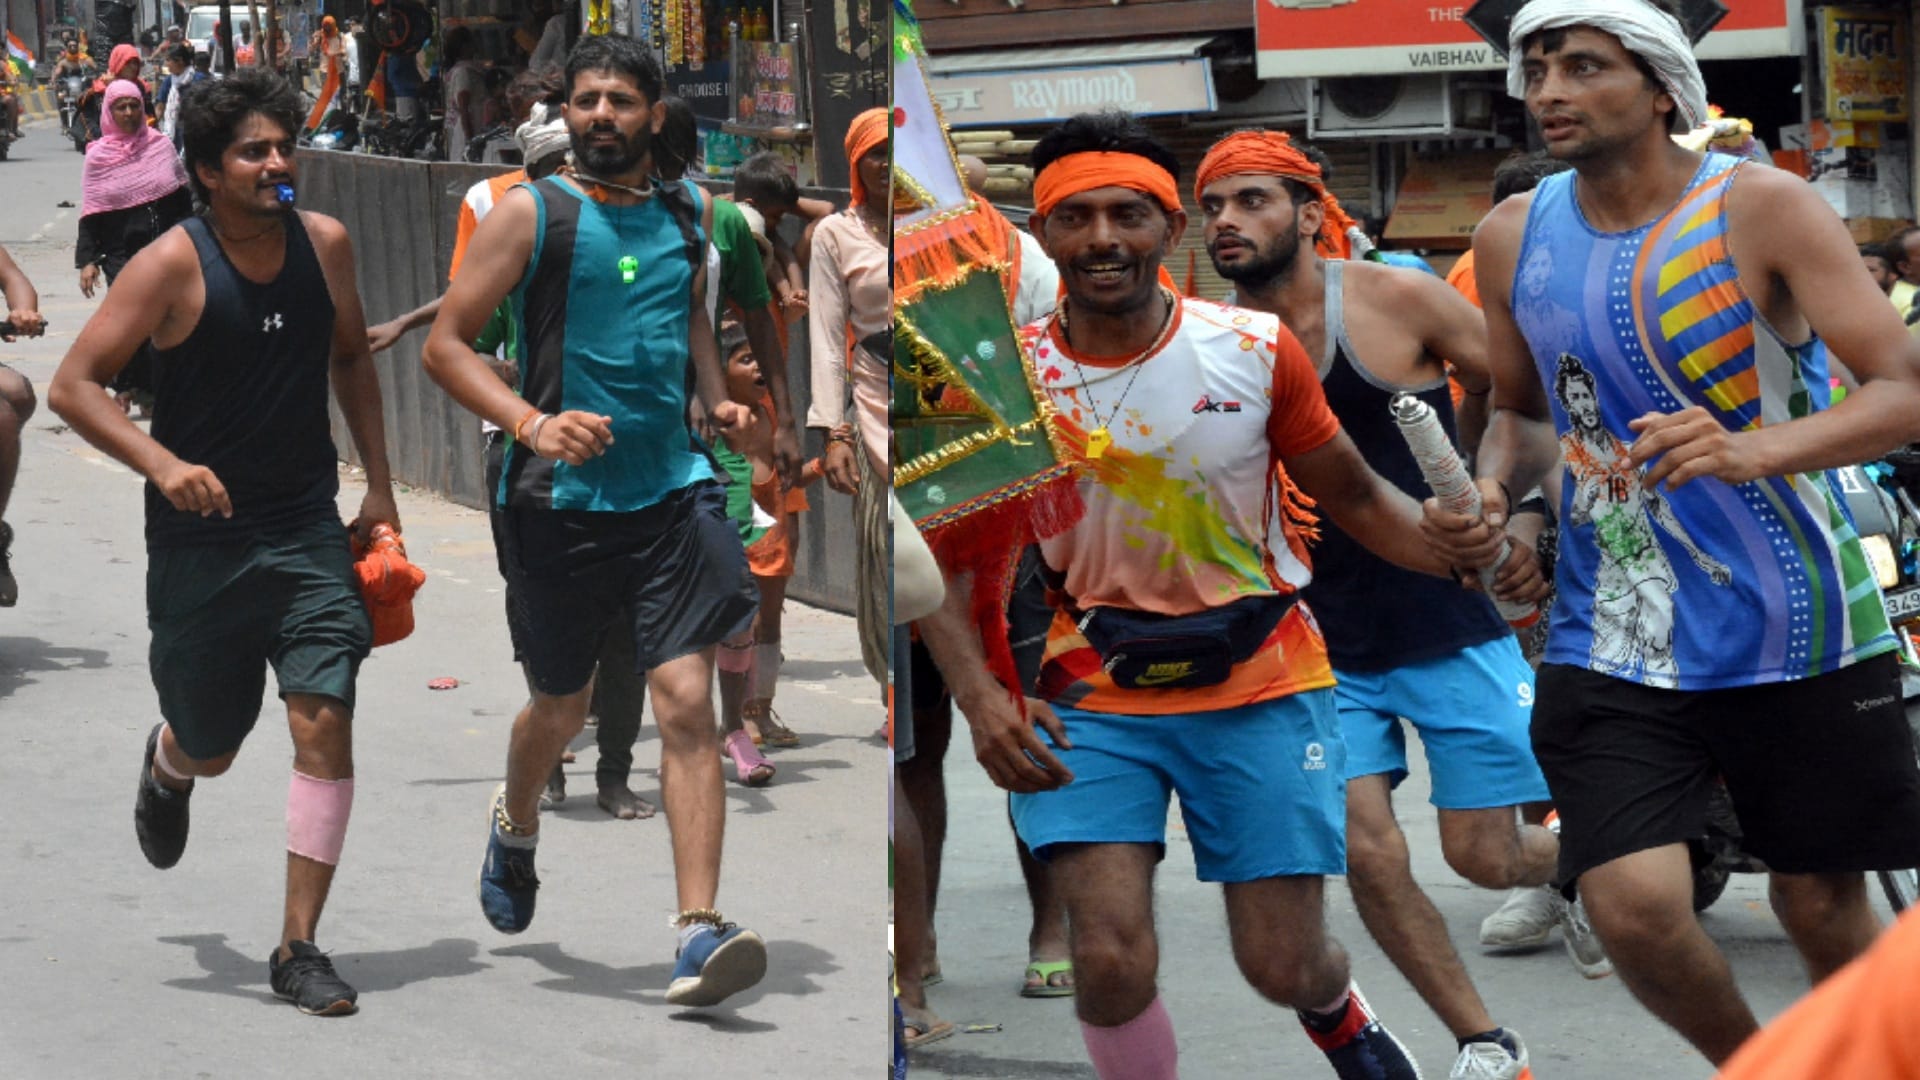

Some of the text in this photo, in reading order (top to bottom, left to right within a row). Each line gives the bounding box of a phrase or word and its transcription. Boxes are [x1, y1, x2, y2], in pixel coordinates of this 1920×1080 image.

[1427, 8, 1464, 22] THE
[1834, 19, 1897, 61] मदन
[1408, 49, 1486, 66] VAIBHAV
[678, 82, 721, 97] CHOOSE
